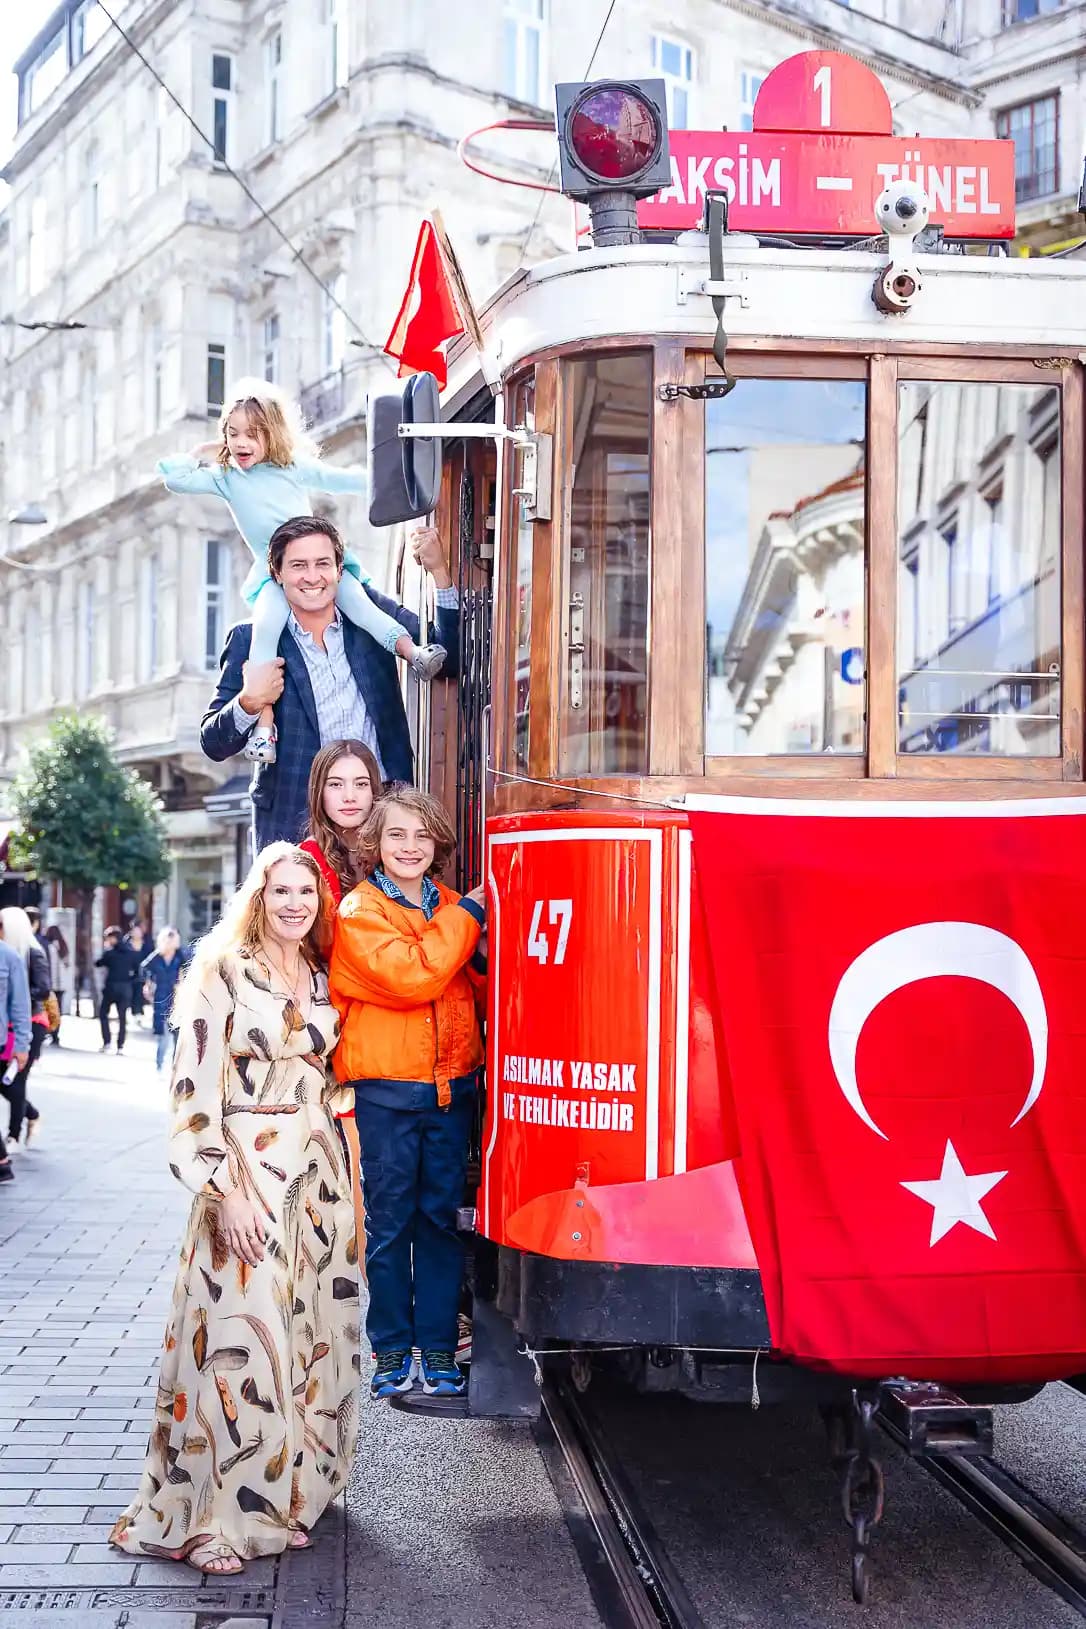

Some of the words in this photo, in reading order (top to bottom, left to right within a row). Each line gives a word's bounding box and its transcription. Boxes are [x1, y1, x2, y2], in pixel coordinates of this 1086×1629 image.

[813, 66, 831, 127] 1
[645, 143, 781, 206] AKSİM
[527, 899, 573, 965] 47
[503, 1054, 564, 1088] ASILMAK
[570, 1061, 637, 1092] YASAK
[503, 1092, 516, 1120] VE
[518, 1093, 634, 1132] TEHLİKELİDİR
